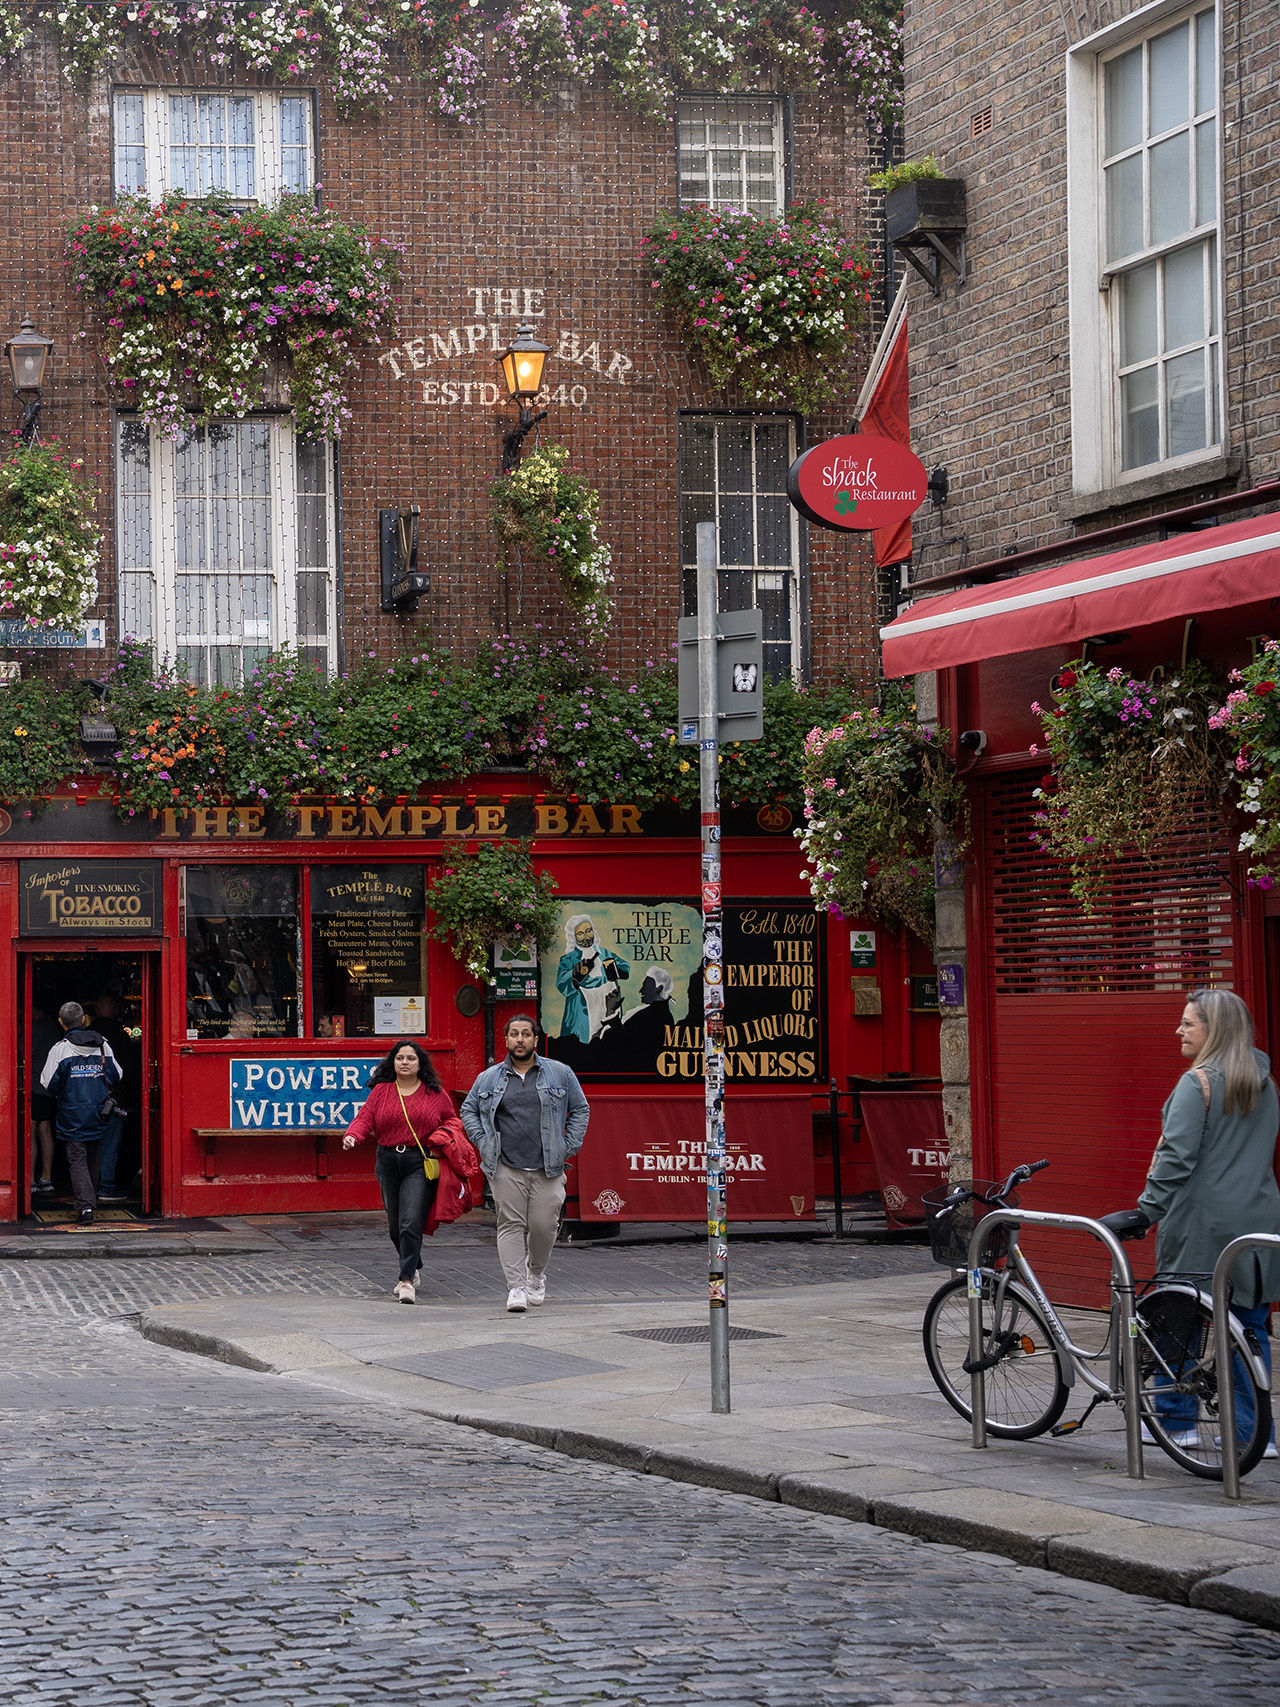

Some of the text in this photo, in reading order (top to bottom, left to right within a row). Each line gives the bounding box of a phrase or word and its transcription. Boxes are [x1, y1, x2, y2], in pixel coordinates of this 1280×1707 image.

[467, 287, 545, 317] THE
[554, 329, 633, 385] BAR
[526, 384, 588, 408] 840
[841, 456, 859, 469] The
[822, 457, 878, 489] Shack
[852, 488, 918, 501] Restaurant
[150, 804, 645, 838] THE TEMPLE BAR
[25, 865, 81, 890] Importers
[361, 871, 378, 880] The
[75, 884, 140, 893] FINE SMOKING
[326, 881, 413, 898] TEMPLE BAR
[40, 889, 142, 924] TOBACCO
[61, 917, 150, 926] Always in Stock
[347, 920, 366, 928] Plate,
[632, 911, 672, 928] THE
[783, 913, 816, 935] 1840
[339, 930, 367, 938] Oysters,
[612, 928, 691, 945] TEMPLE
[364, 949, 405, 957] Sandwiches
[632, 945, 673, 962] BAR
[773, 940, 813, 963] THE
[371, 959, 388, 967] Beef
[388, 959, 406, 967] Rolls
[726, 964, 815, 988] EMPEROR
[921, 983, 936, 995] The
[791, 989, 814, 1012] OF
[662, 1012, 818, 1049] MALD LIQUORS
[677, 1140, 707, 1154] TH
[907, 1148, 951, 1167] TEM
[658, 1175, 690, 1183] DUBLIN
